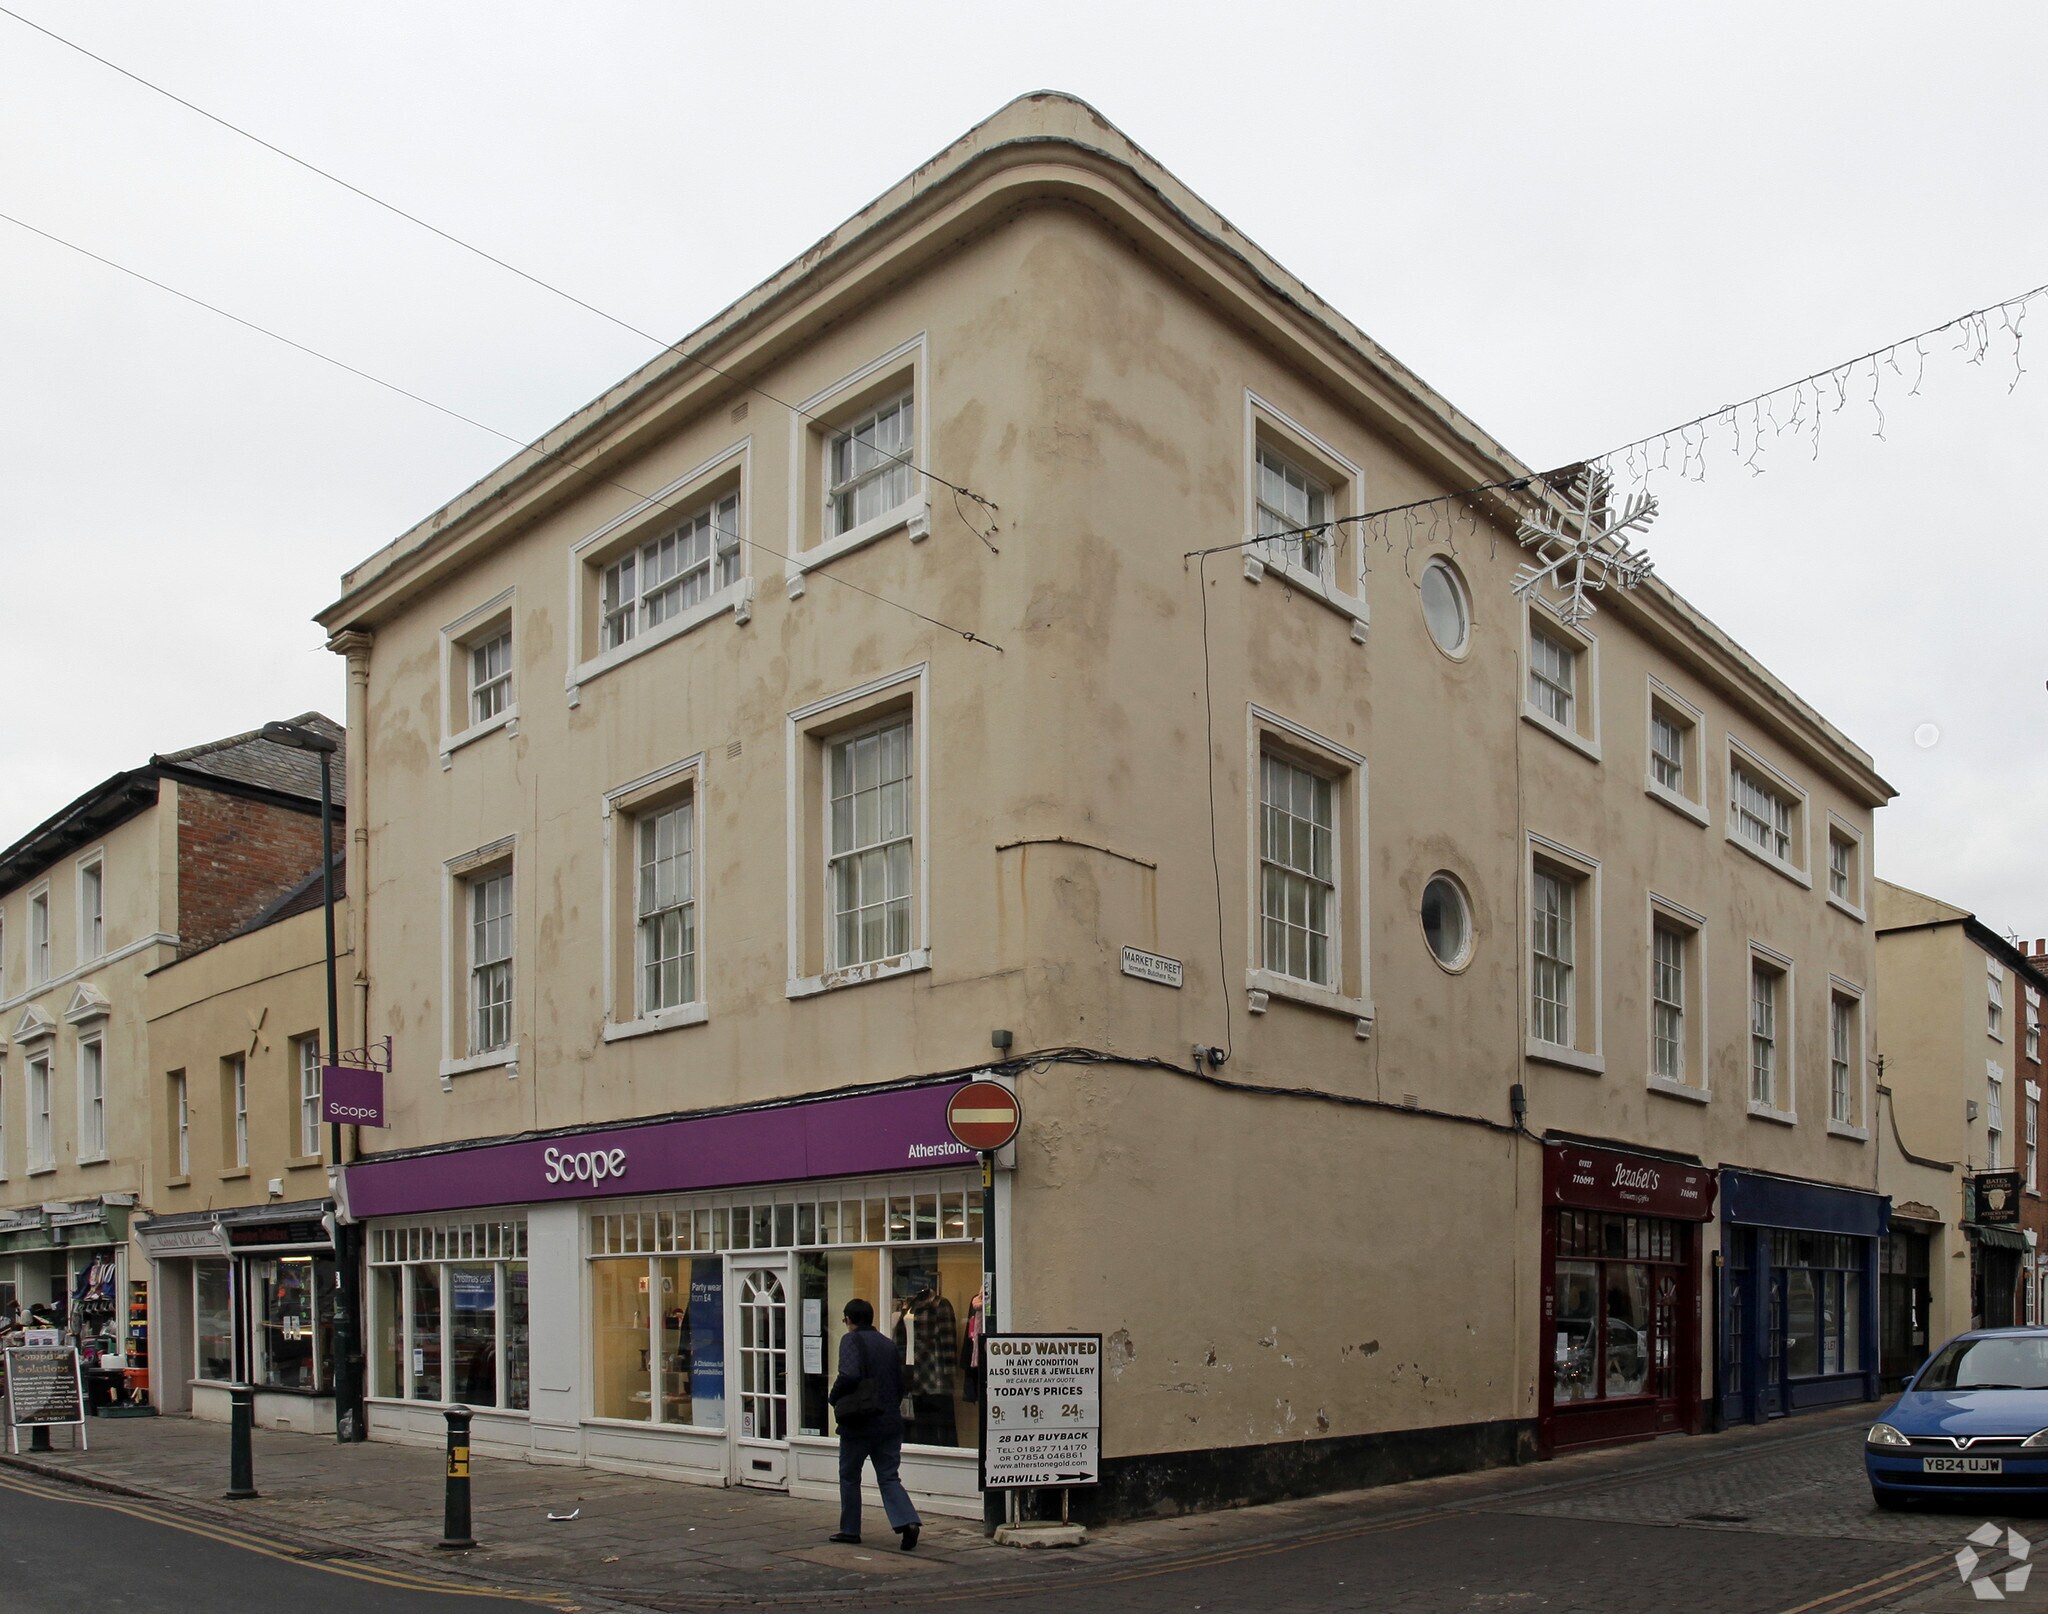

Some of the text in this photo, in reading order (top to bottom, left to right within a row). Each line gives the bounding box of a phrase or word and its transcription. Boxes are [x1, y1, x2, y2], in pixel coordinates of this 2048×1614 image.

[1125, 951, 1180, 974] MARKET STREET
[1129, 964, 1146, 976] formerly
[1148, 969, 1166, 980] Butchers
[330, 1102, 378, 1119] Scope
[544, 1147, 626, 1188] Scope
[982, 1162, 987, 1170] 2
[983, 1175, 986, 1184] 1
[1572, 1174, 1594, 1186] 716692
[1612, 1162, 1660, 1190] Jezabel's
[692, 1283, 706, 1293] Party
[990, 1342, 1097, 1355] GOLD WANTED
[18, 1364, 68, 1373] Solutions
[994, 1387, 1083, 1396] TODAY'S PRICES
[992, 1406, 1000, 1418] 9
[1022, 1405, 1038, 1417] 18
[1062, 1404, 1078, 1417] 24
[1038, 1432, 1089, 1441] BUYBACK
[994, 1460, 1087, 1469] www.atherstonegold.com
[1926, 1459, 1999, 1471] Y824 UJW
[990, 1474, 1050, 1484] HARWILLS
